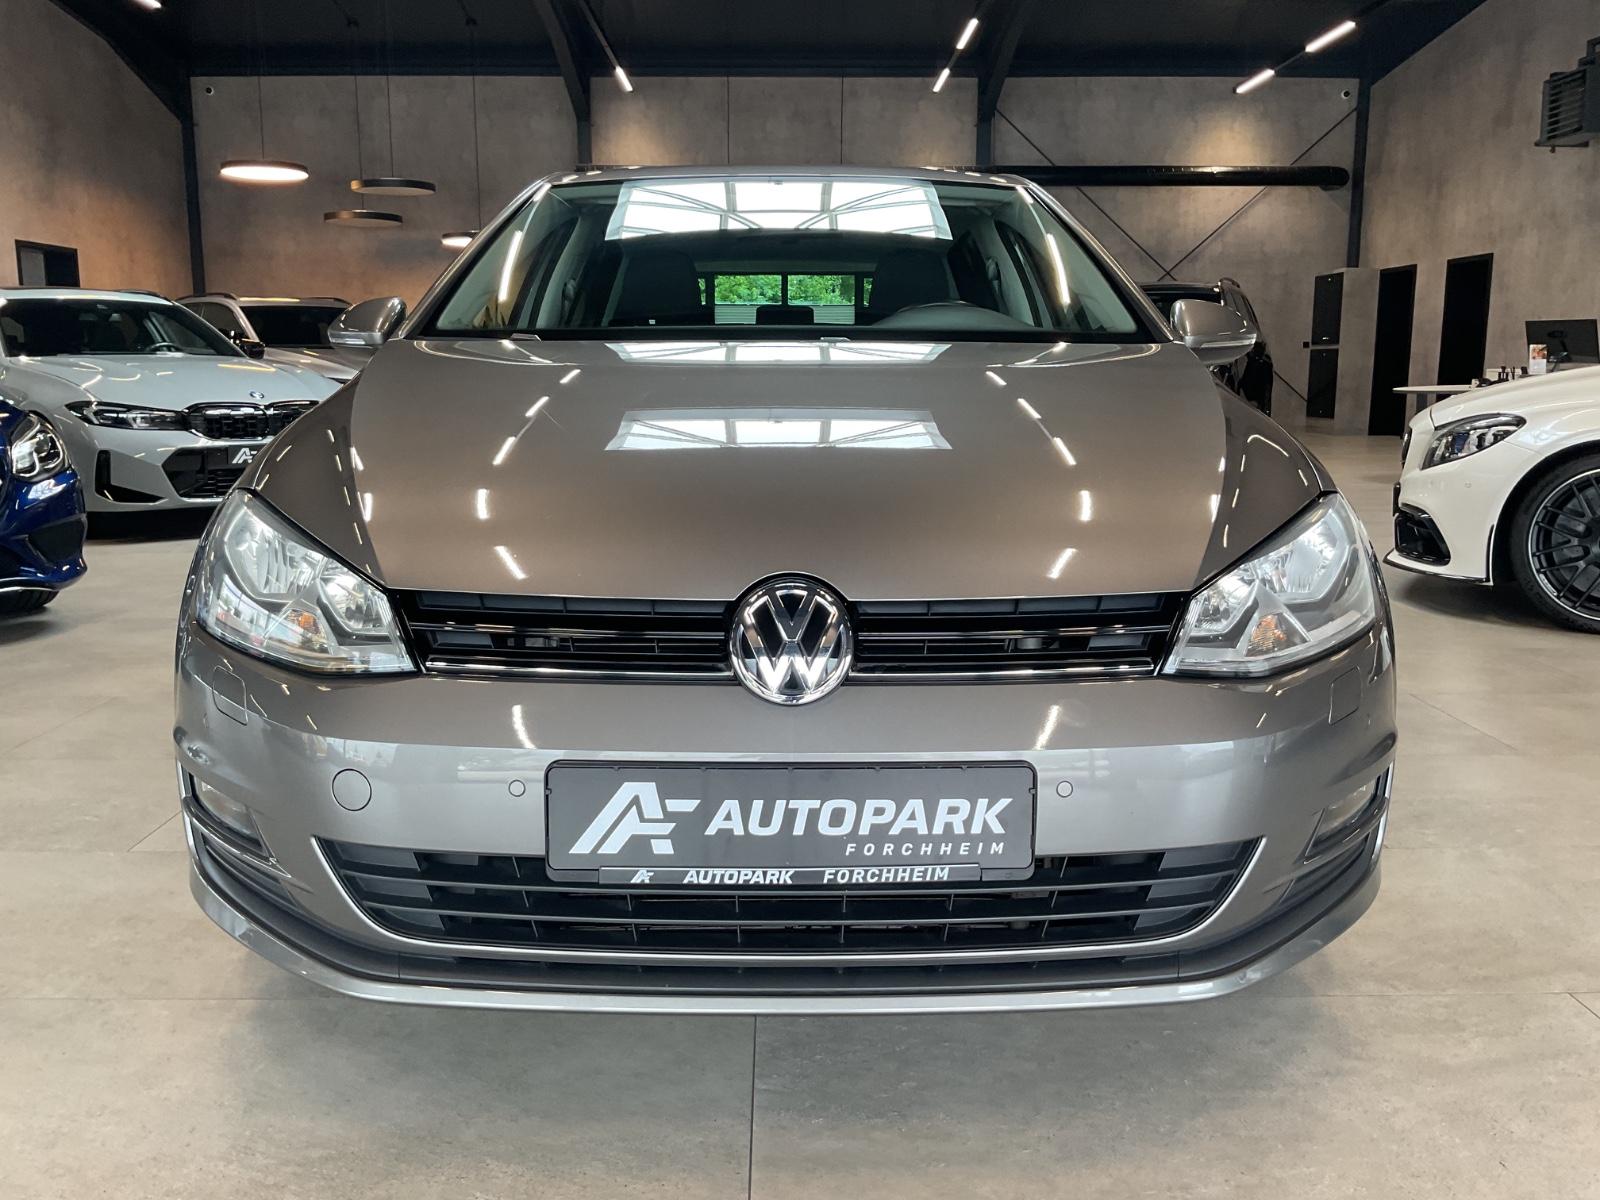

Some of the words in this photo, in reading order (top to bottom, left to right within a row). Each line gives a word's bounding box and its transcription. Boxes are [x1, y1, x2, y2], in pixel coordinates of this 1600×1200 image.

[704, 798, 1013, 836] AUTOPARK
[845, 842, 1004, 856] FORCHHEIM
[682, 869, 796, 885] AUTOPARK
[823, 866, 950, 884] FORCHHEIM
